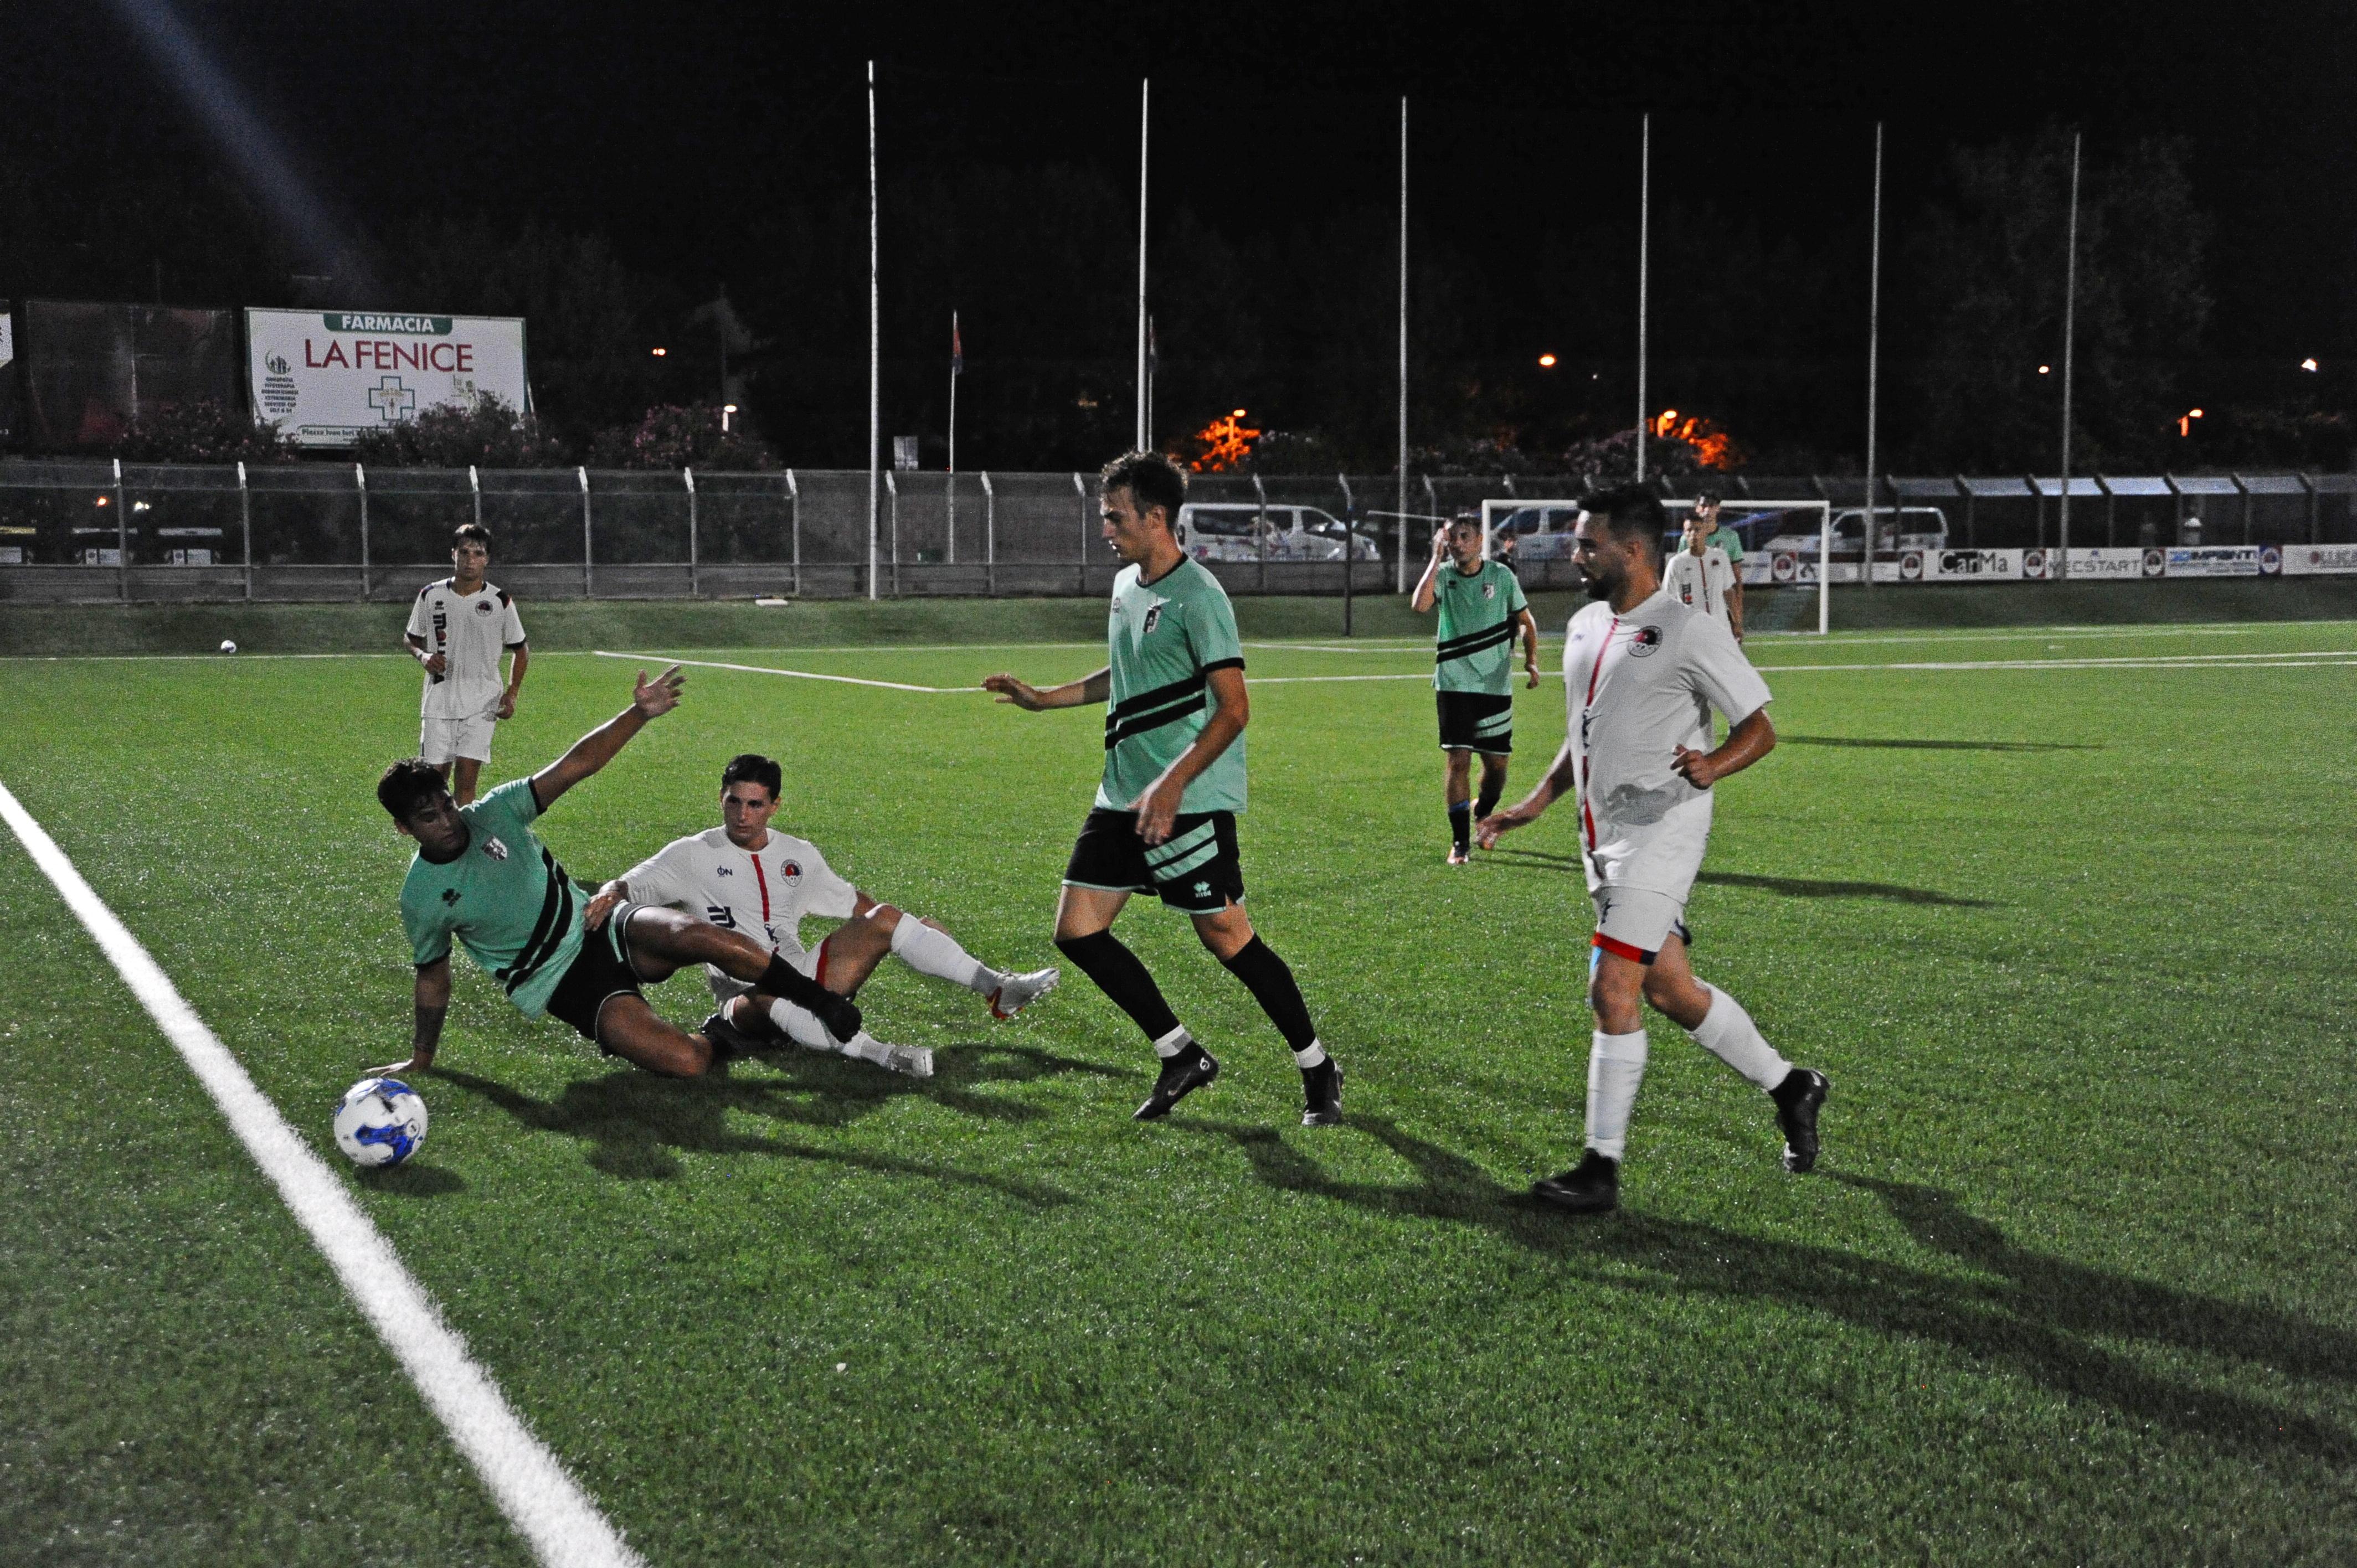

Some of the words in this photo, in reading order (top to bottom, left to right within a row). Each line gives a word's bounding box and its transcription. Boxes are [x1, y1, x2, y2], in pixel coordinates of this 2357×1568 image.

[342, 314, 435, 333] FARMACIA
[305, 338, 350, 369] LA
[354, 340, 474, 373] FENICE
